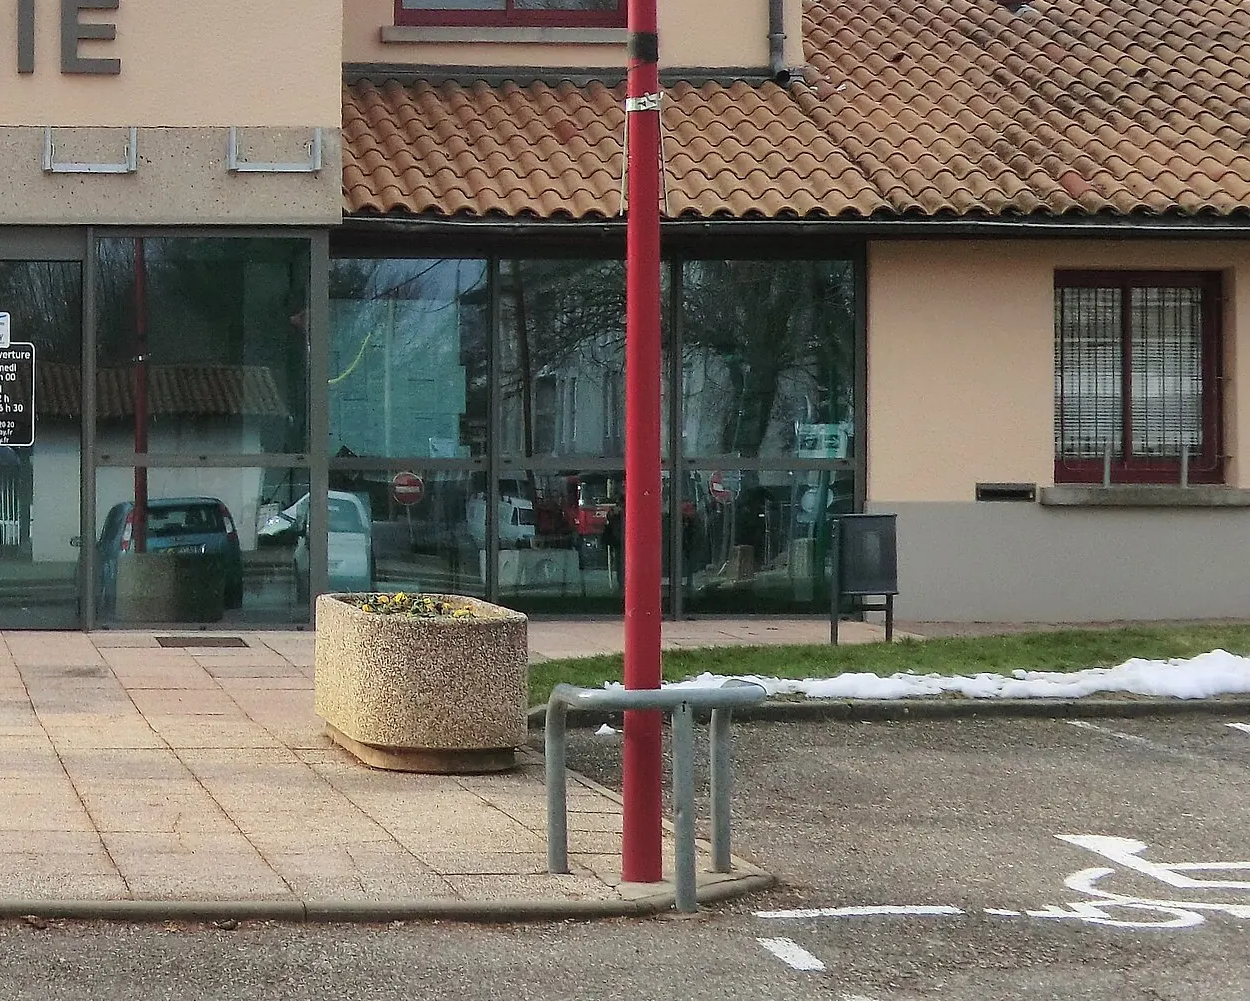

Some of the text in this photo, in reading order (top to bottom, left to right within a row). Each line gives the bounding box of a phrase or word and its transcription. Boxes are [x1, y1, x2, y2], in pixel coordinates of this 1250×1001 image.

[5, 372, 16, 381] 00
[3, 394, 10, 403] h
[5, 403, 11, 412] h
[12, 404, 24, 412] 30
